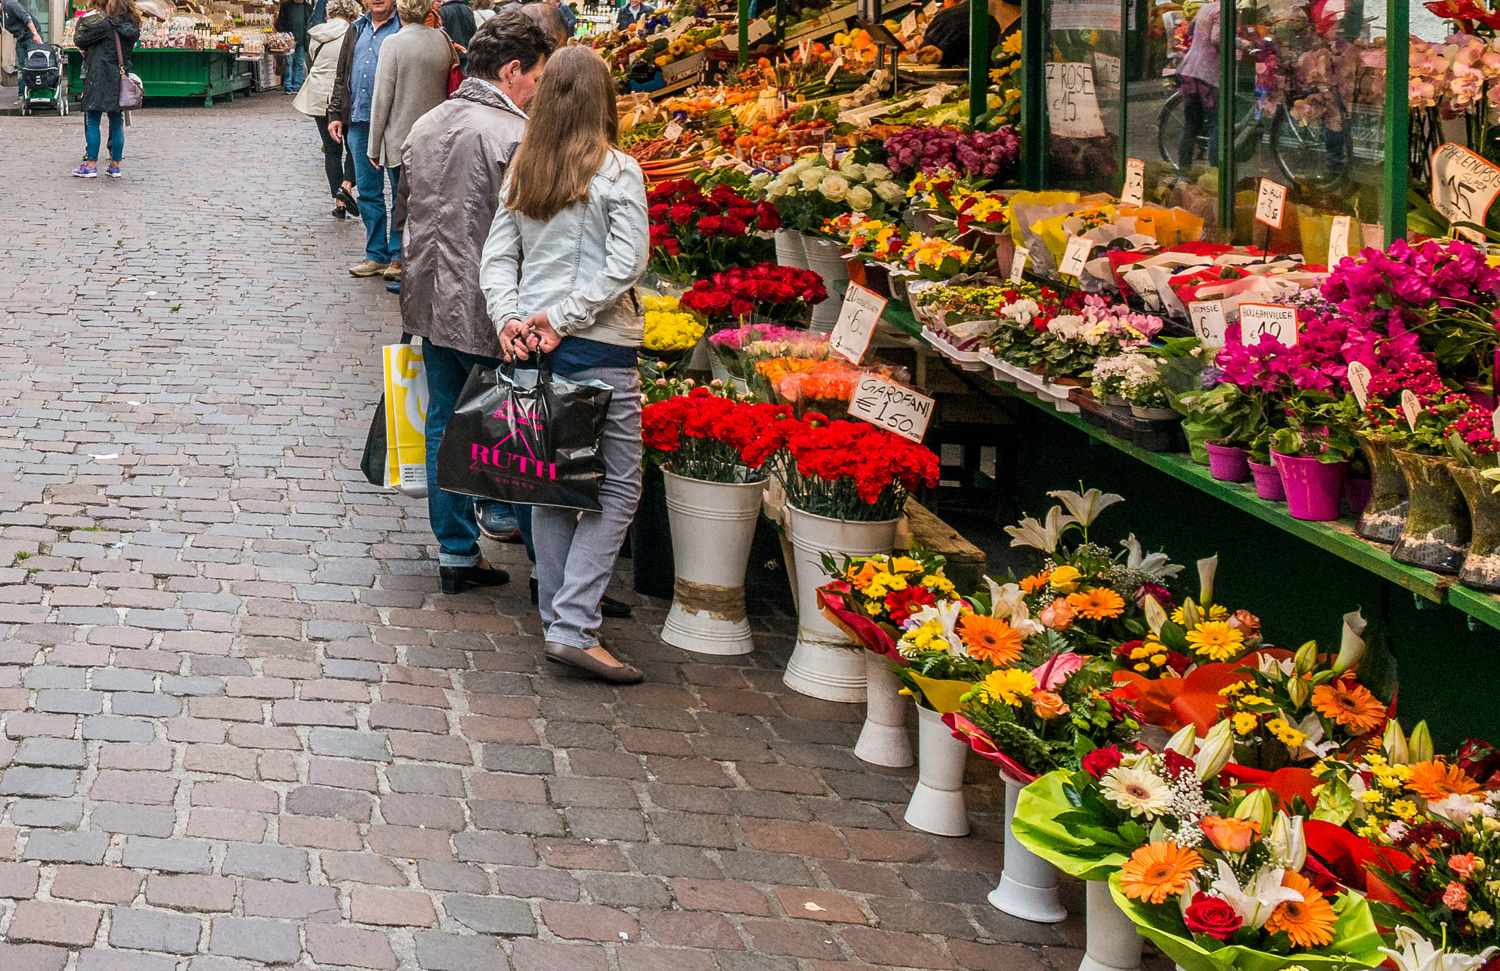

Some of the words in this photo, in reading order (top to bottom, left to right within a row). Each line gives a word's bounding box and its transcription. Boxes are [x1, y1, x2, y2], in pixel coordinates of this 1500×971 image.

[1045, 64, 1054, 88] 7
[1061, 63, 1095, 96] ROSE
[846, 285, 860, 302] 10
[861, 379, 931, 419] GAROFANI
[470, 442, 557, 481] RUTH
